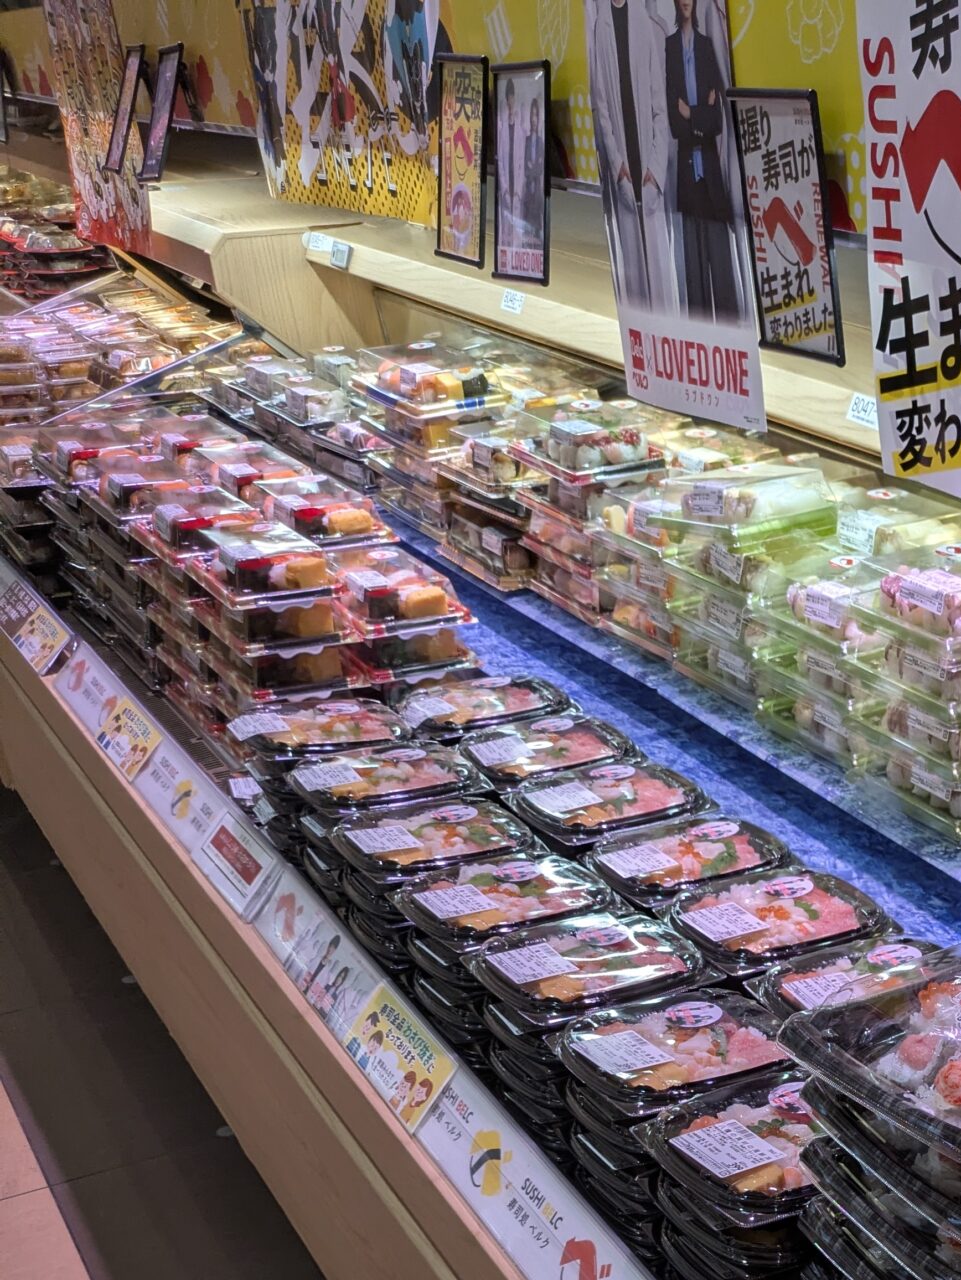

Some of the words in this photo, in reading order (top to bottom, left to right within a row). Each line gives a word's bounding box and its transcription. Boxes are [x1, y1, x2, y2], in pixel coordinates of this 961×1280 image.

[740, 105, 772, 156] 握り
[863, 37, 904, 266] SUSHI
[761, 134, 815, 192] 寿司が
[747, 176, 768, 263] SUSHI
[811, 182, 832, 292] RENEWAL
[761, 266, 815, 314] 生まれ
[769, 303, 834, 344] 変わりました
[652, 334, 710, 387] LOVED
[712, 345, 750, 397] ONE
[430, 1101, 445, 1123] 司処
[442, 1085, 459, 1106] USHI
[521, 1177, 546, 1211] SUSHI
[542, 1203, 563, 1230] BELC
[529, 1224, 550, 1249] ベルク
